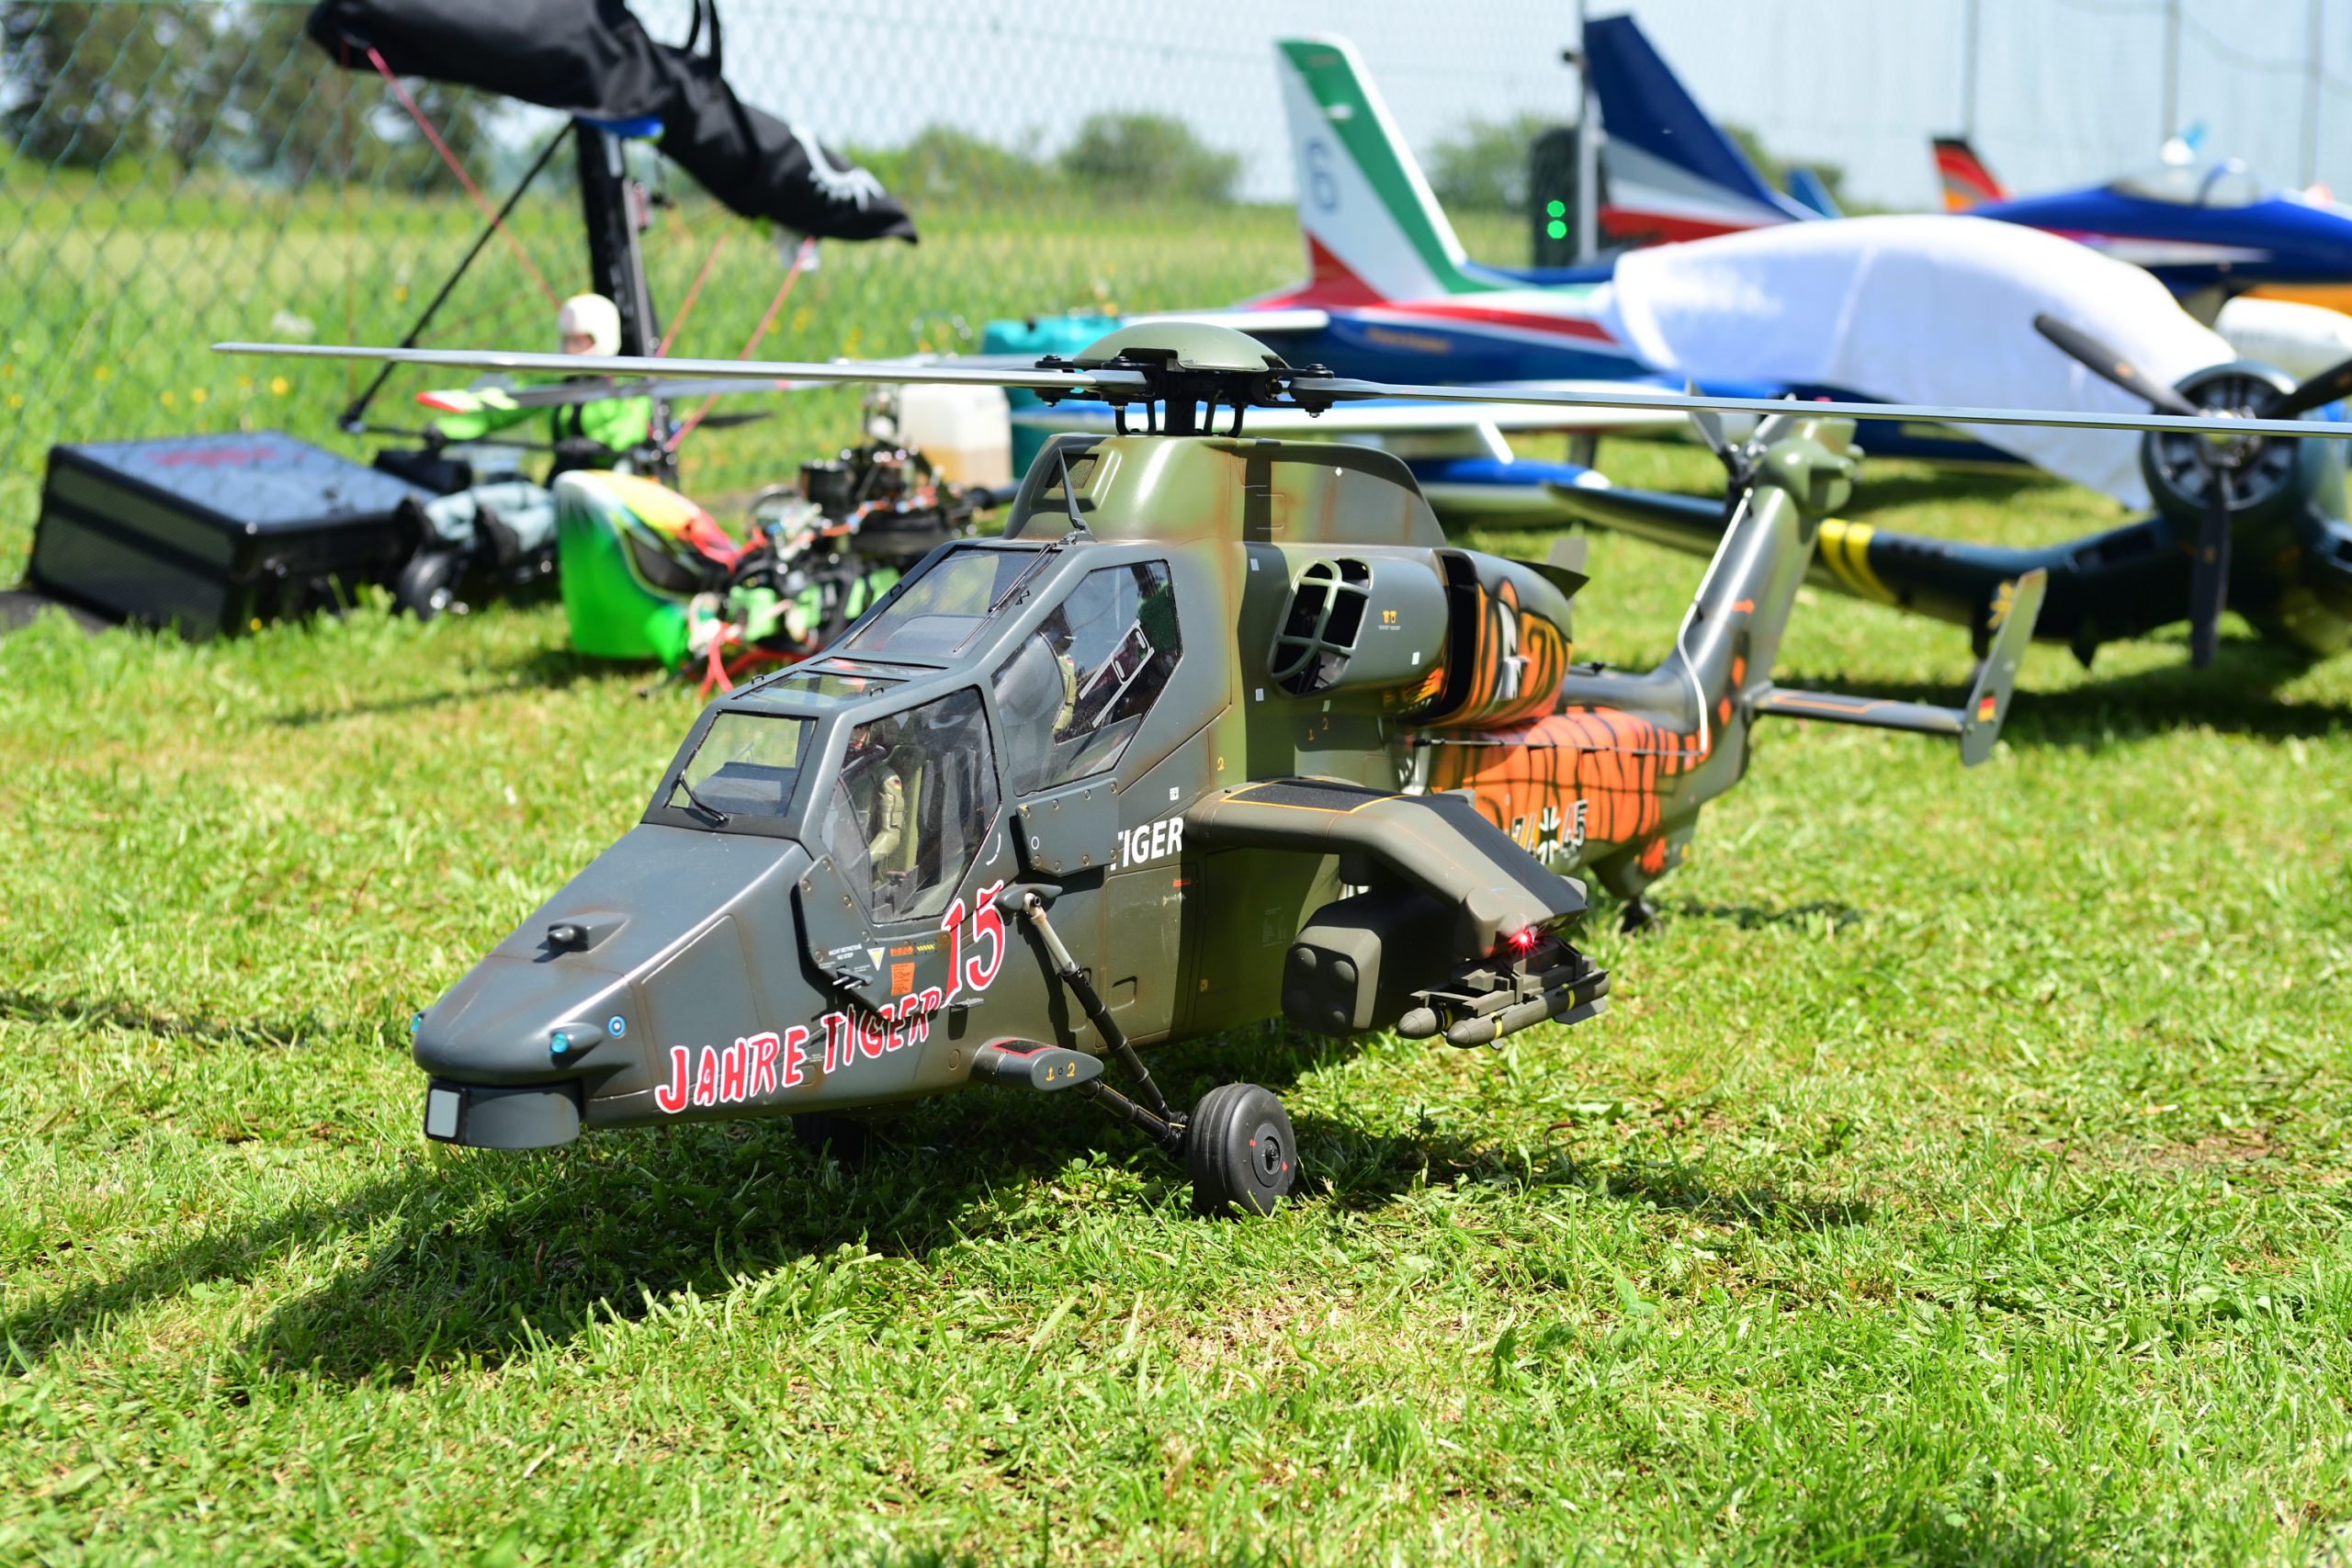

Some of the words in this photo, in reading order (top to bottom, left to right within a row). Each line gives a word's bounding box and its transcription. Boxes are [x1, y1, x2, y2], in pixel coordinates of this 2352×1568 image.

[941, 879, 1006, 1010] 15
[655, 1025, 810, 1114] JAHRE
[821, 986, 943, 1074] TIGER
